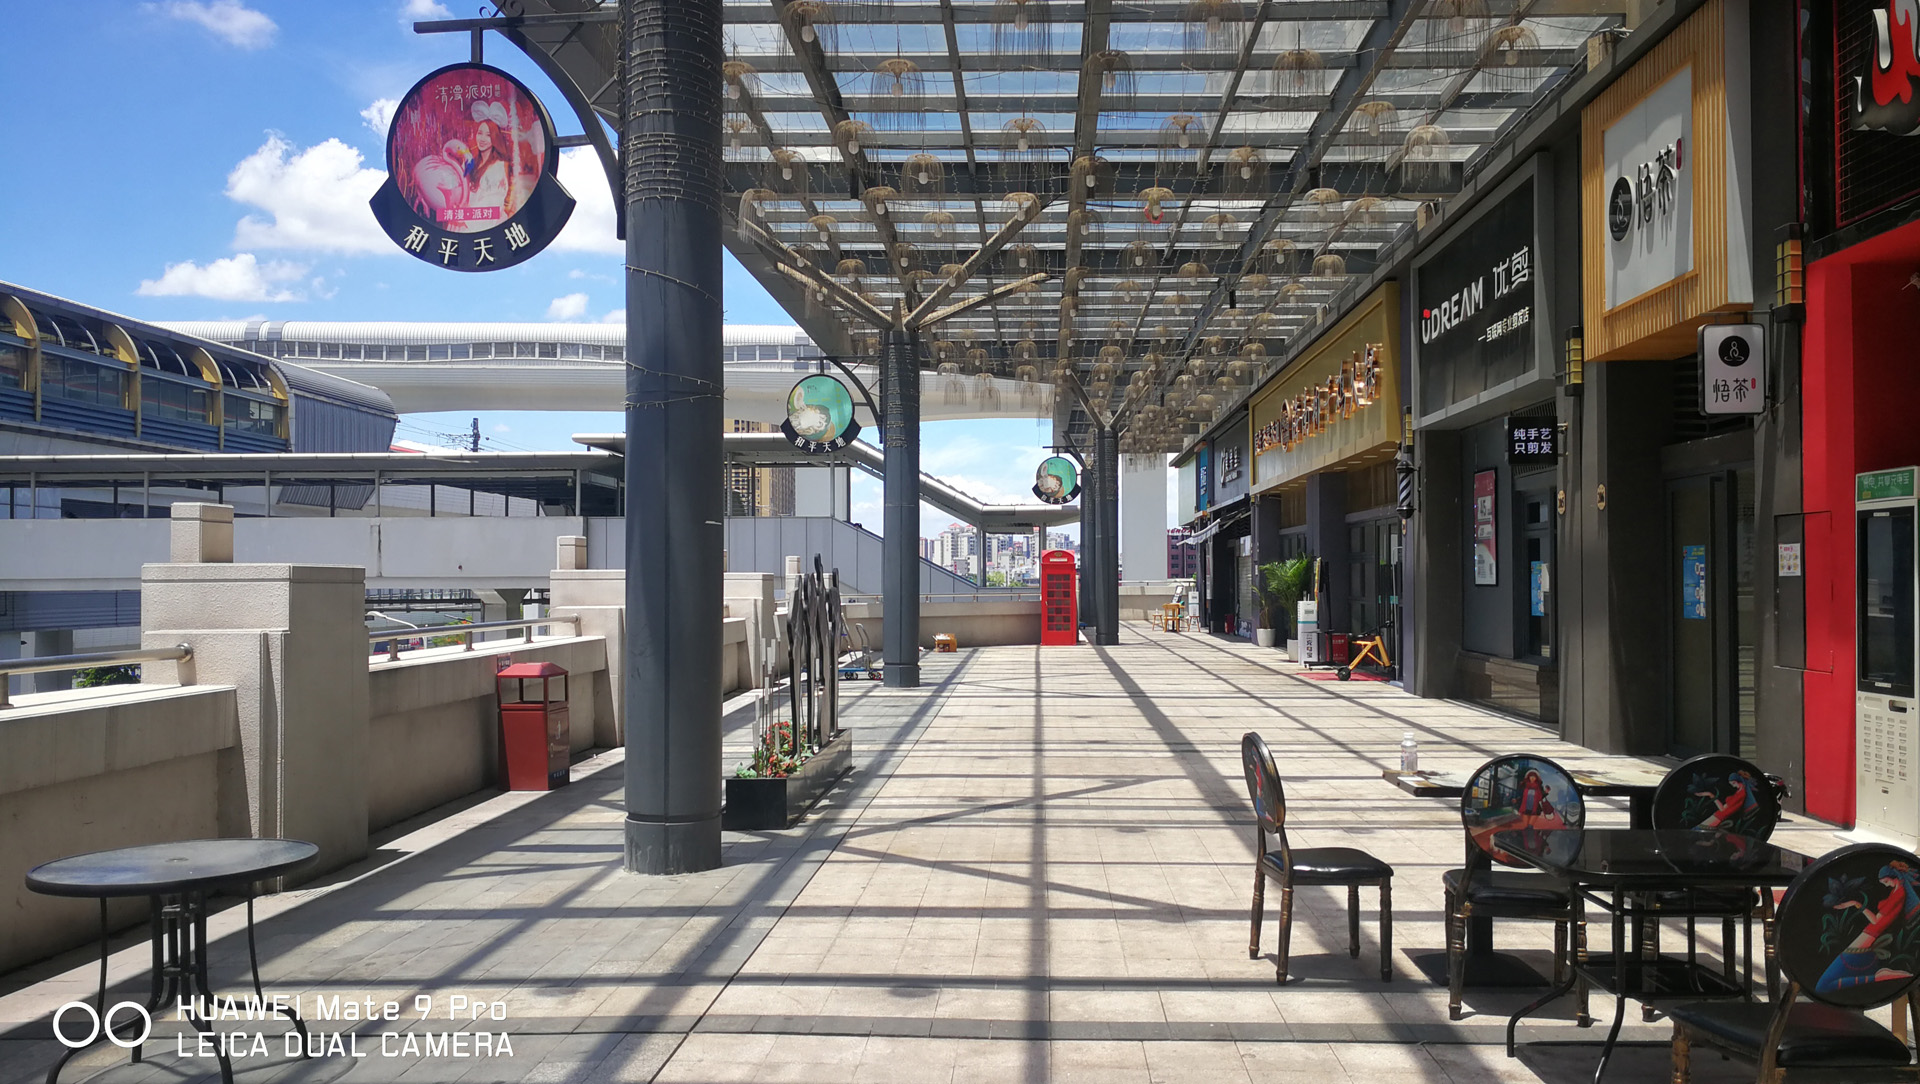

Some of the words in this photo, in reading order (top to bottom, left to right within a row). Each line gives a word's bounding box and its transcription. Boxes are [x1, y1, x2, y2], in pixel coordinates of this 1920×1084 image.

[1635, 143, 1677, 231] 悟茶
[403, 222, 531, 266] 和平天地
[1712, 377, 1750, 403] 悟茶
[794, 435, 847, 453] 和平天地
[1513, 428, 1552, 440] 纯手艺
[1514, 441, 1552, 454] 只剪发
